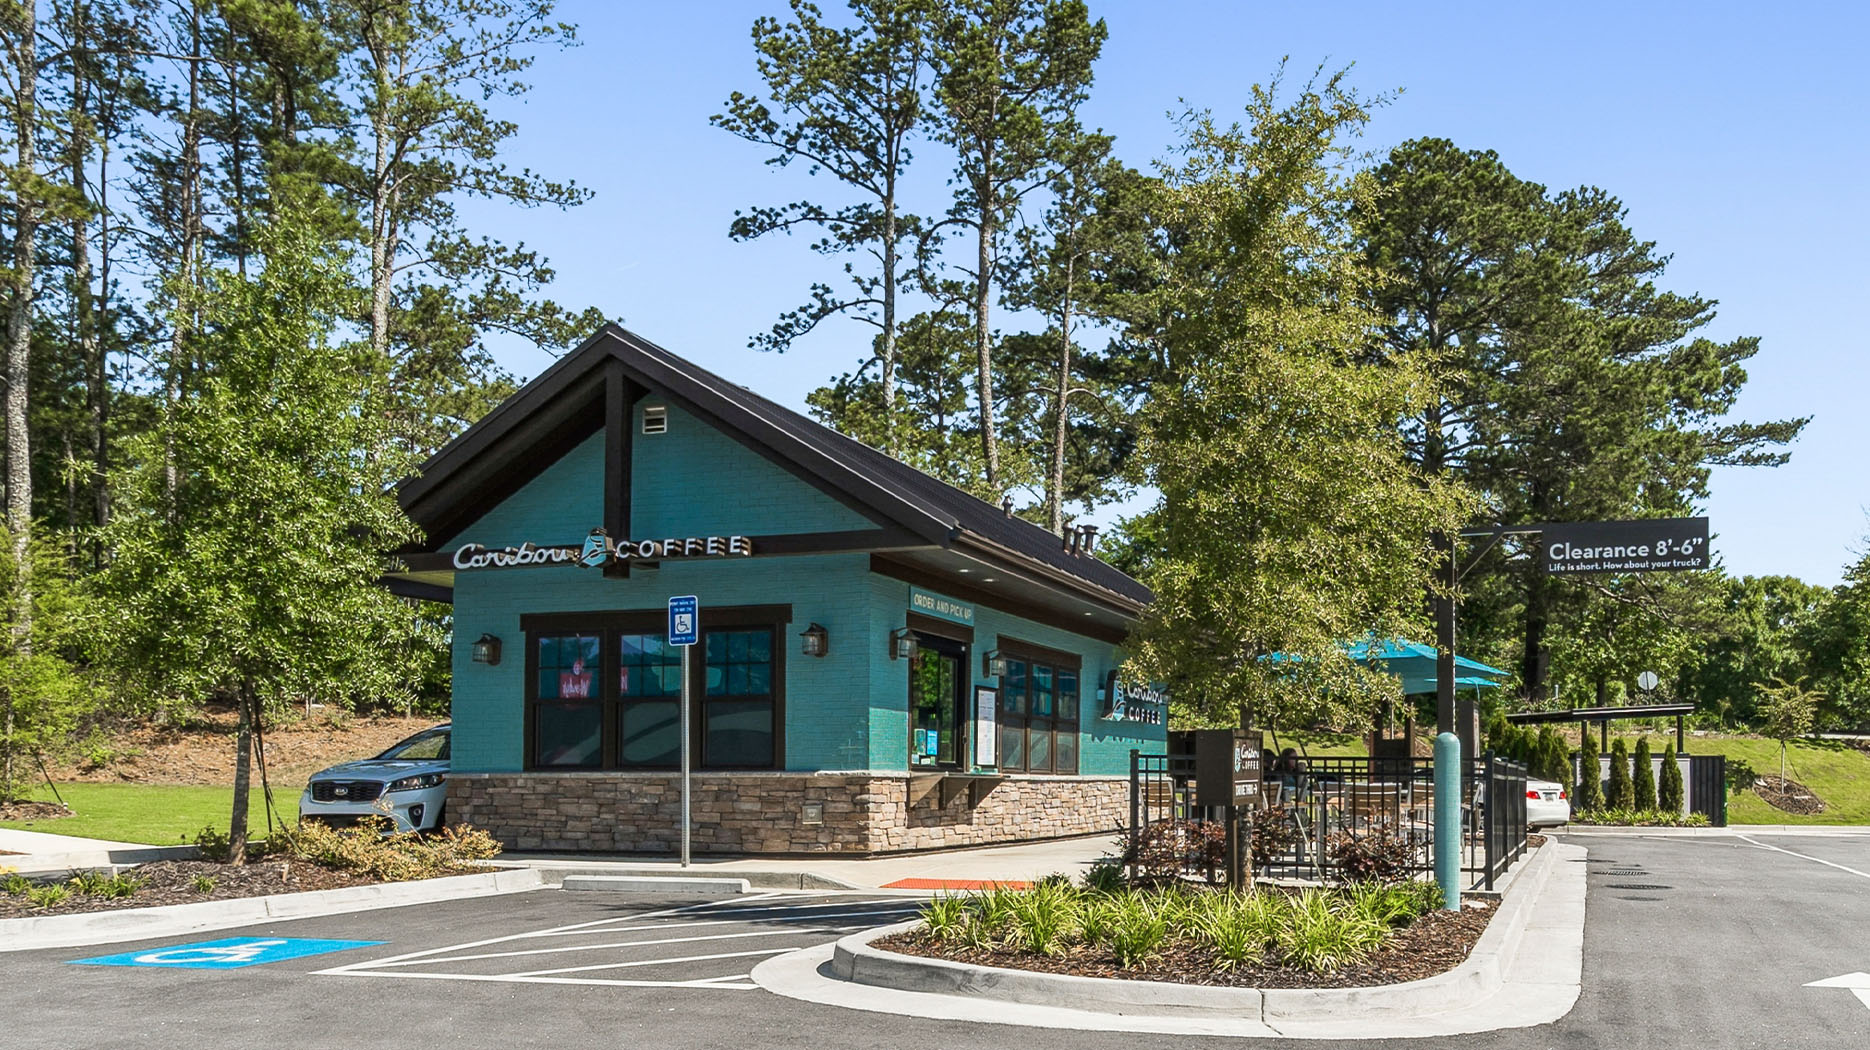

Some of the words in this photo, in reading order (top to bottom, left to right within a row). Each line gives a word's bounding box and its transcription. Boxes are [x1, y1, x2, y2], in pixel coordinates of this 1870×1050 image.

[453, 542, 569, 570] Caribou
[616, 535, 742, 558] COFFEE
[1549, 542, 1650, 560] Clearance
[1548, 563, 1566, 572] Life
[1567, 562, 1575, 571] is
[1576, 562, 1602, 571] short.
[1603, 561, 1623, 570] How
[1624, 560, 1649, 569] about
[1651, 560, 1671, 570] your
[1672, 558, 1701, 568] truck?
[914, 593, 935, 610] ORDER
[936, 600, 950, 614] AND
[950, 603, 964, 618] PICK
[964, 607, 972, 620] UP
[1129, 706, 1161, 725] COFFEE
[1241, 760, 1259, 770] COFFEE
